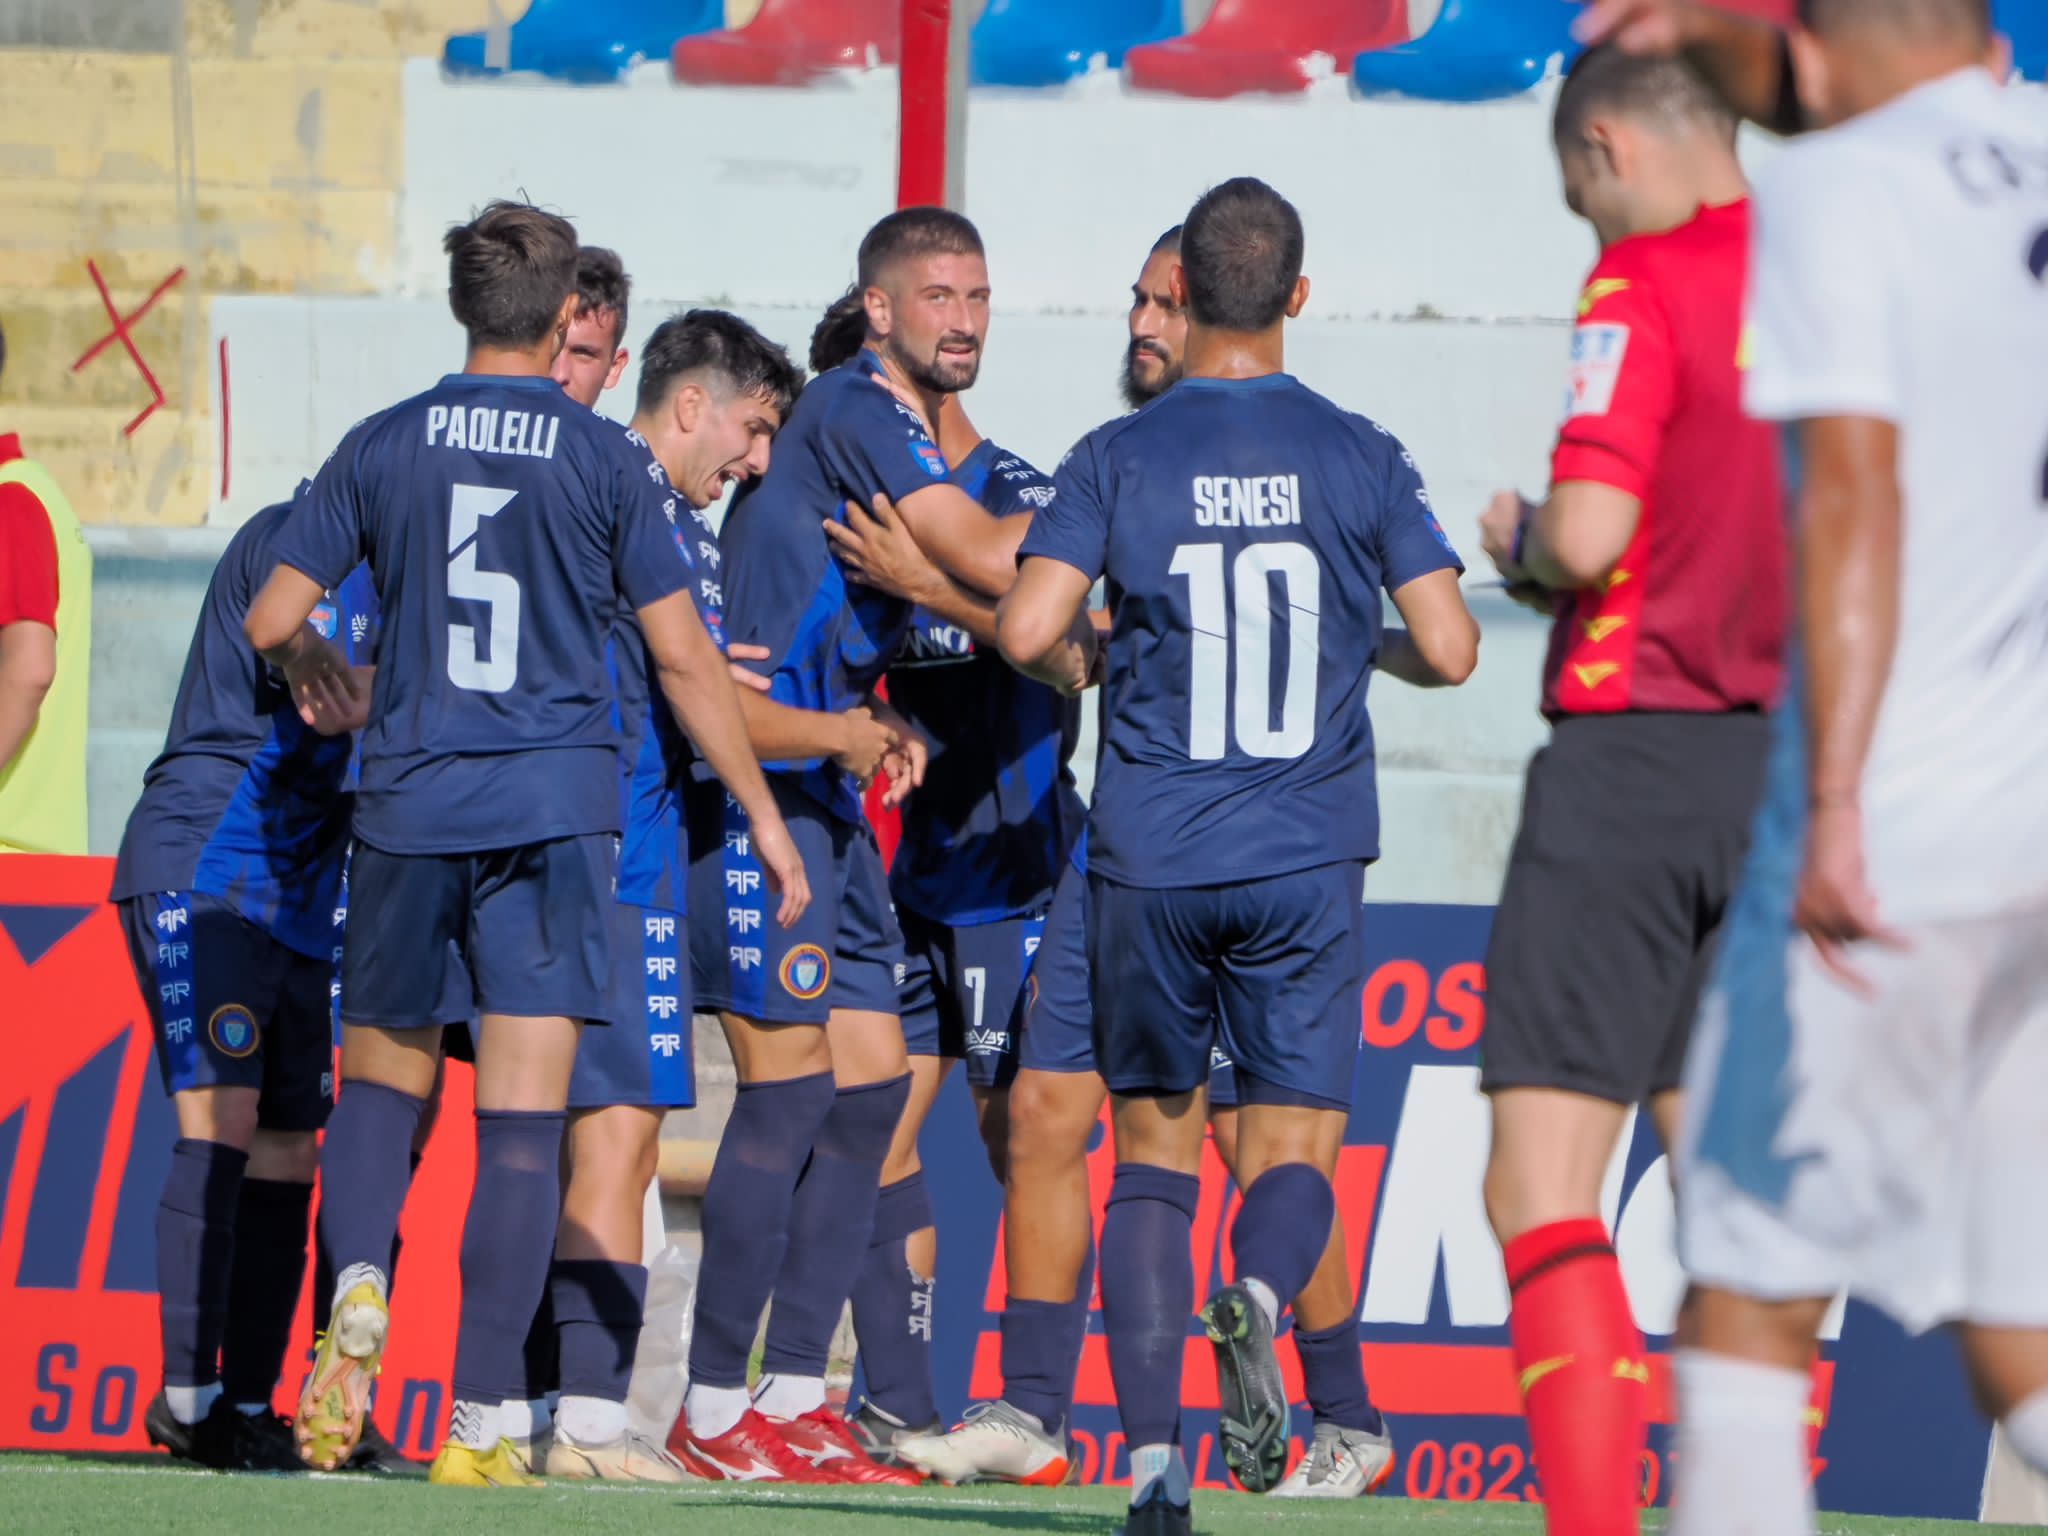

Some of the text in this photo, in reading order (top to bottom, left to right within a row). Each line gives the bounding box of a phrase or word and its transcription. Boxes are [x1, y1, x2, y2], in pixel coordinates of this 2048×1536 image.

[427, 405, 560, 459] PAOLELLI
[1193, 474, 1301, 527] SENESI
[447, 483, 520, 693] 5
[1168, 542, 1320, 760] 10
